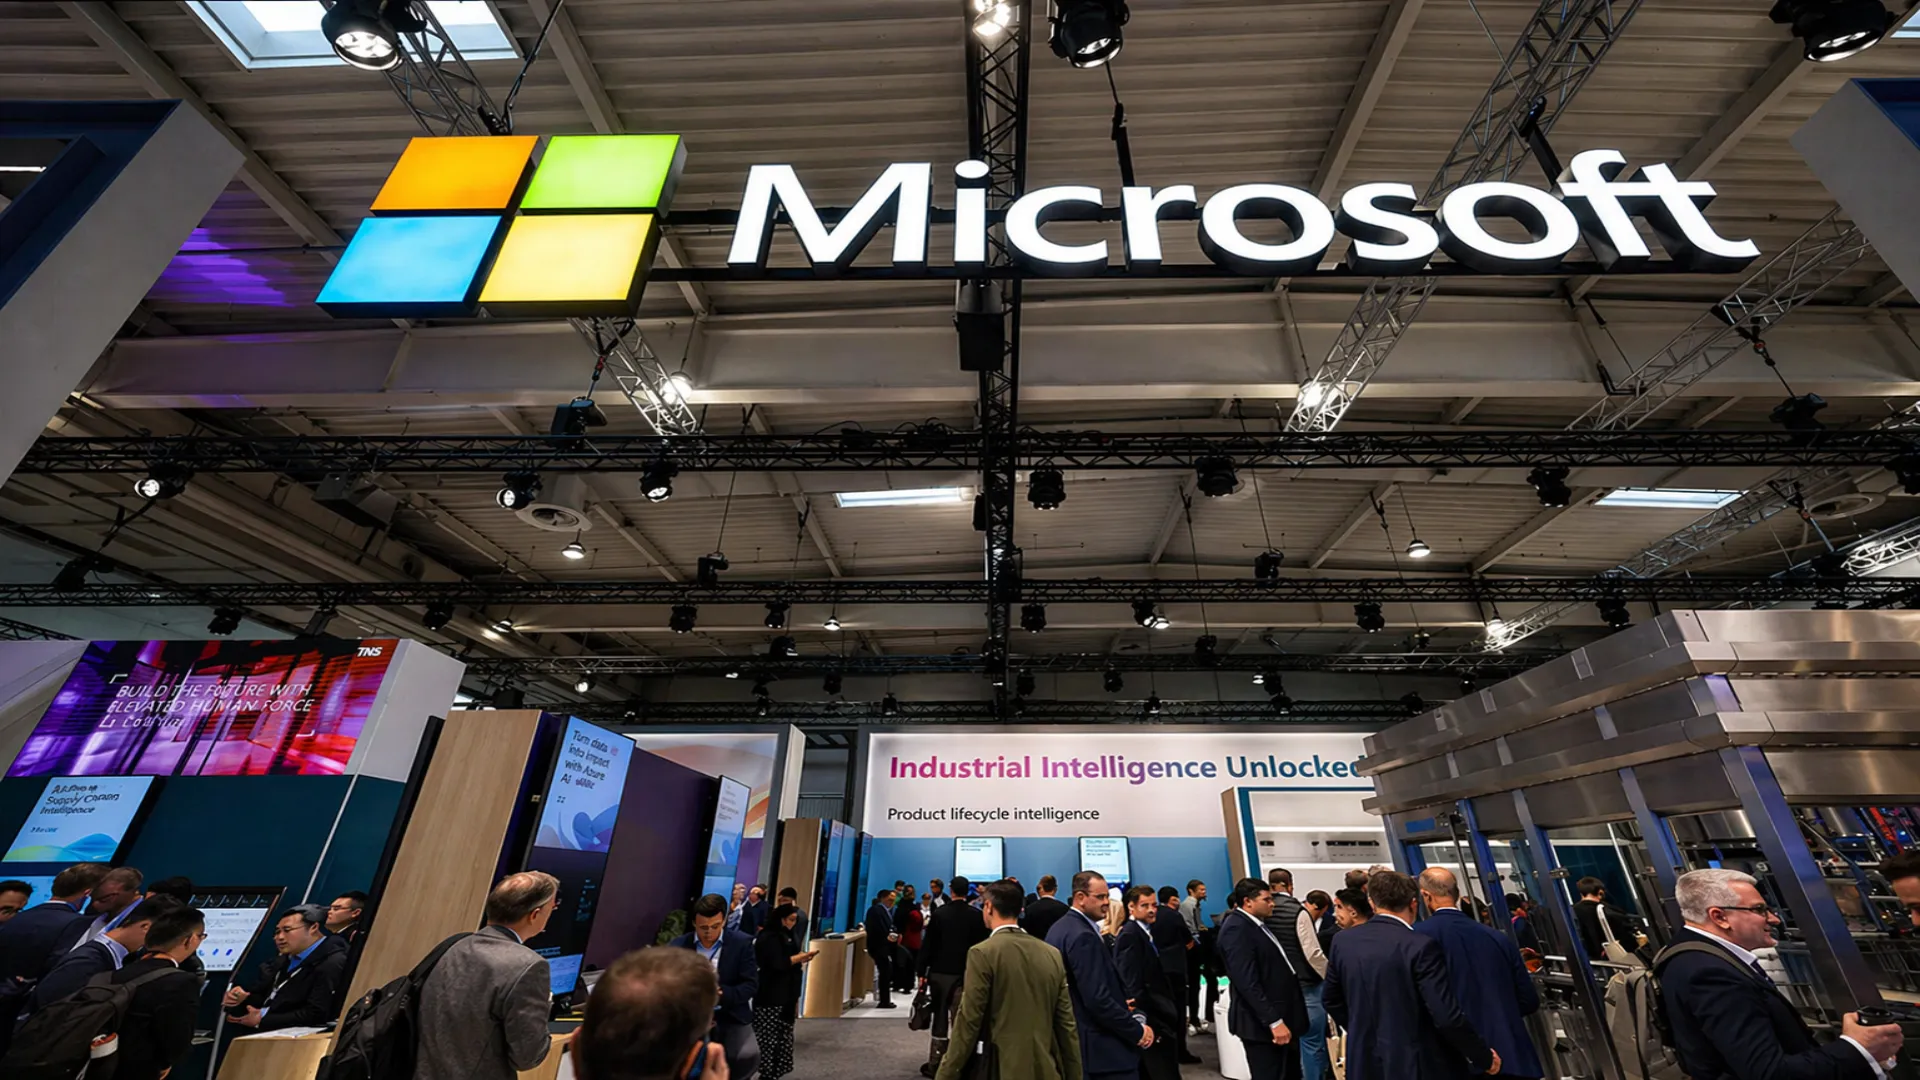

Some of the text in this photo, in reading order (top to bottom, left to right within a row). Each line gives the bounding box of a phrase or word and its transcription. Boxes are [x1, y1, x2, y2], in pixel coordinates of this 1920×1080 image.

[727, 149, 1762, 266] Microsoft
[357, 646, 382, 657] TNS
[116, 684, 168, 698] BUILD
[173, 684, 201, 698] THE
[270, 684, 312, 696] WITH
[106, 699, 313, 714] ELEVATED HUMAN FORCE
[573, 730, 590, 745] Turn
[890, 756, 1031, 778] Industrial
[1042, 756, 1217, 785] Intelligence
[888, 806, 1099, 824] Product lifecycle intelligence
